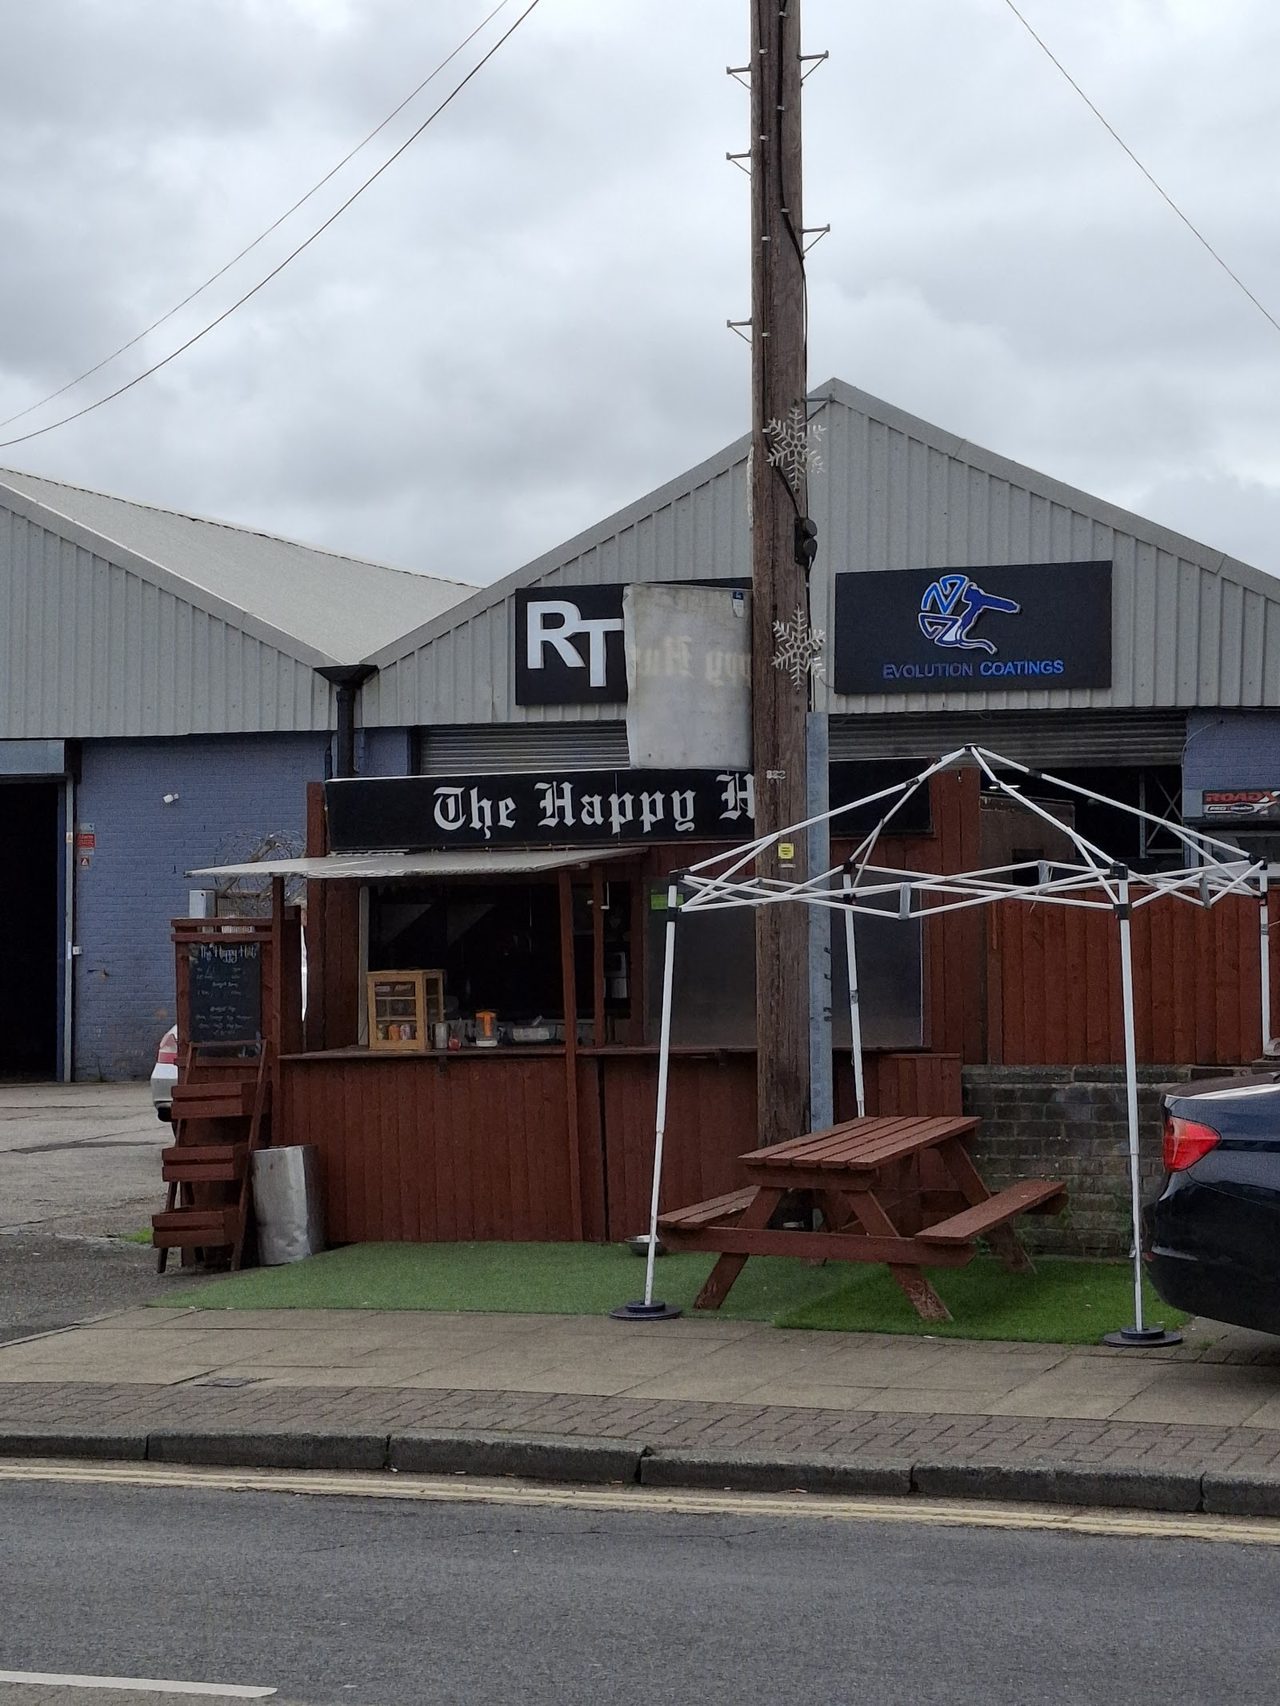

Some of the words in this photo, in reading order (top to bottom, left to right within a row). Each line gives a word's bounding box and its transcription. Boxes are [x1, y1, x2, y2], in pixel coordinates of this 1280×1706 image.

[882, 663, 973, 680] EVOLUTION
[979, 659, 1065, 676] COATINGS
[433, 786, 518, 840] The
[534, 780, 697, 835] Happy
